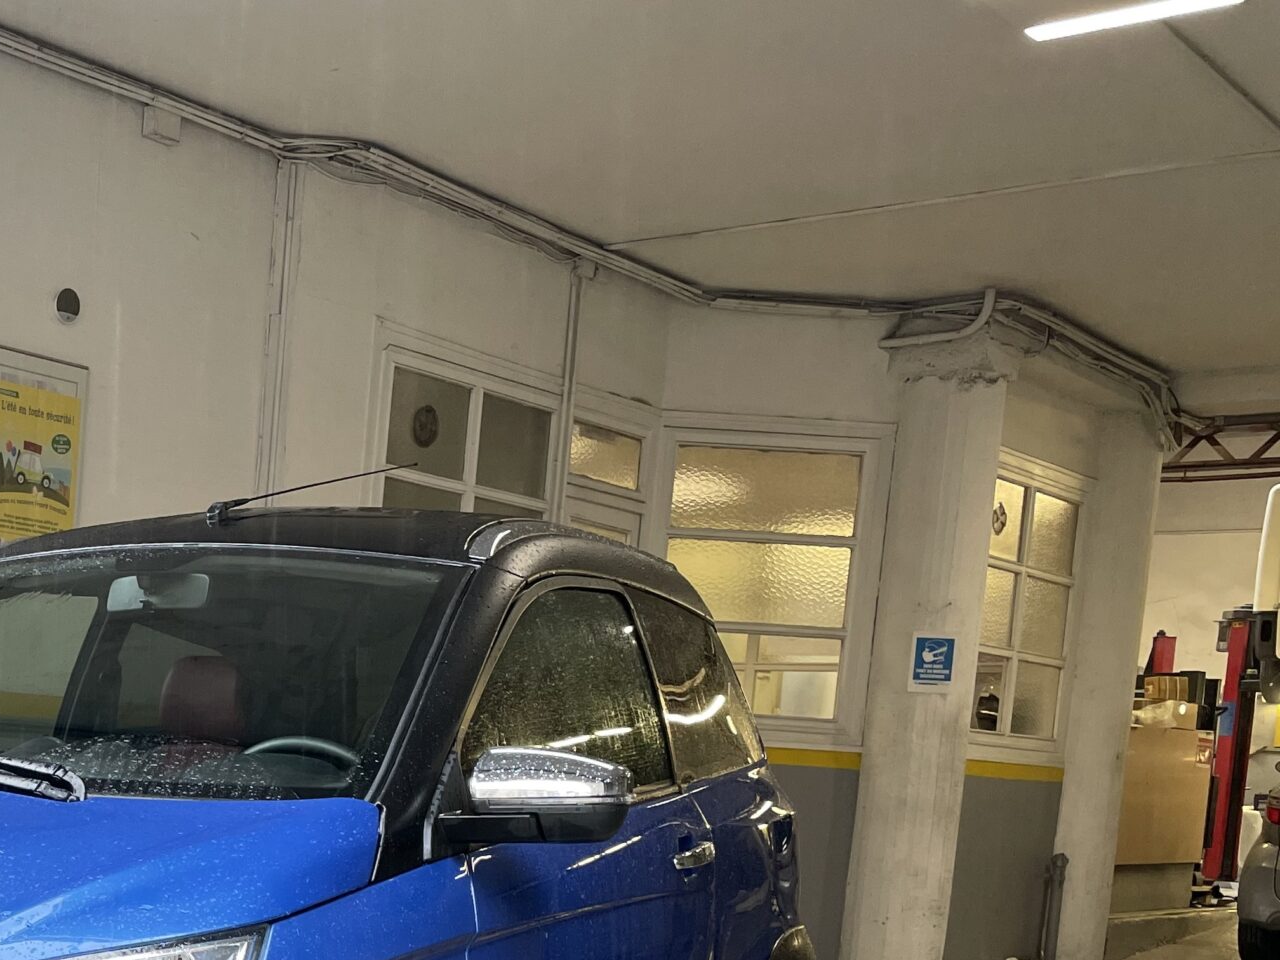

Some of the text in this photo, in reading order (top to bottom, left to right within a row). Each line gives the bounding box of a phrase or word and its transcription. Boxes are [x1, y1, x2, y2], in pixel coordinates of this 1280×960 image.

[1, 400, 17, 412] L'été
[19, 406, 27, 415] en
[28, 405, 45, 419] toute
